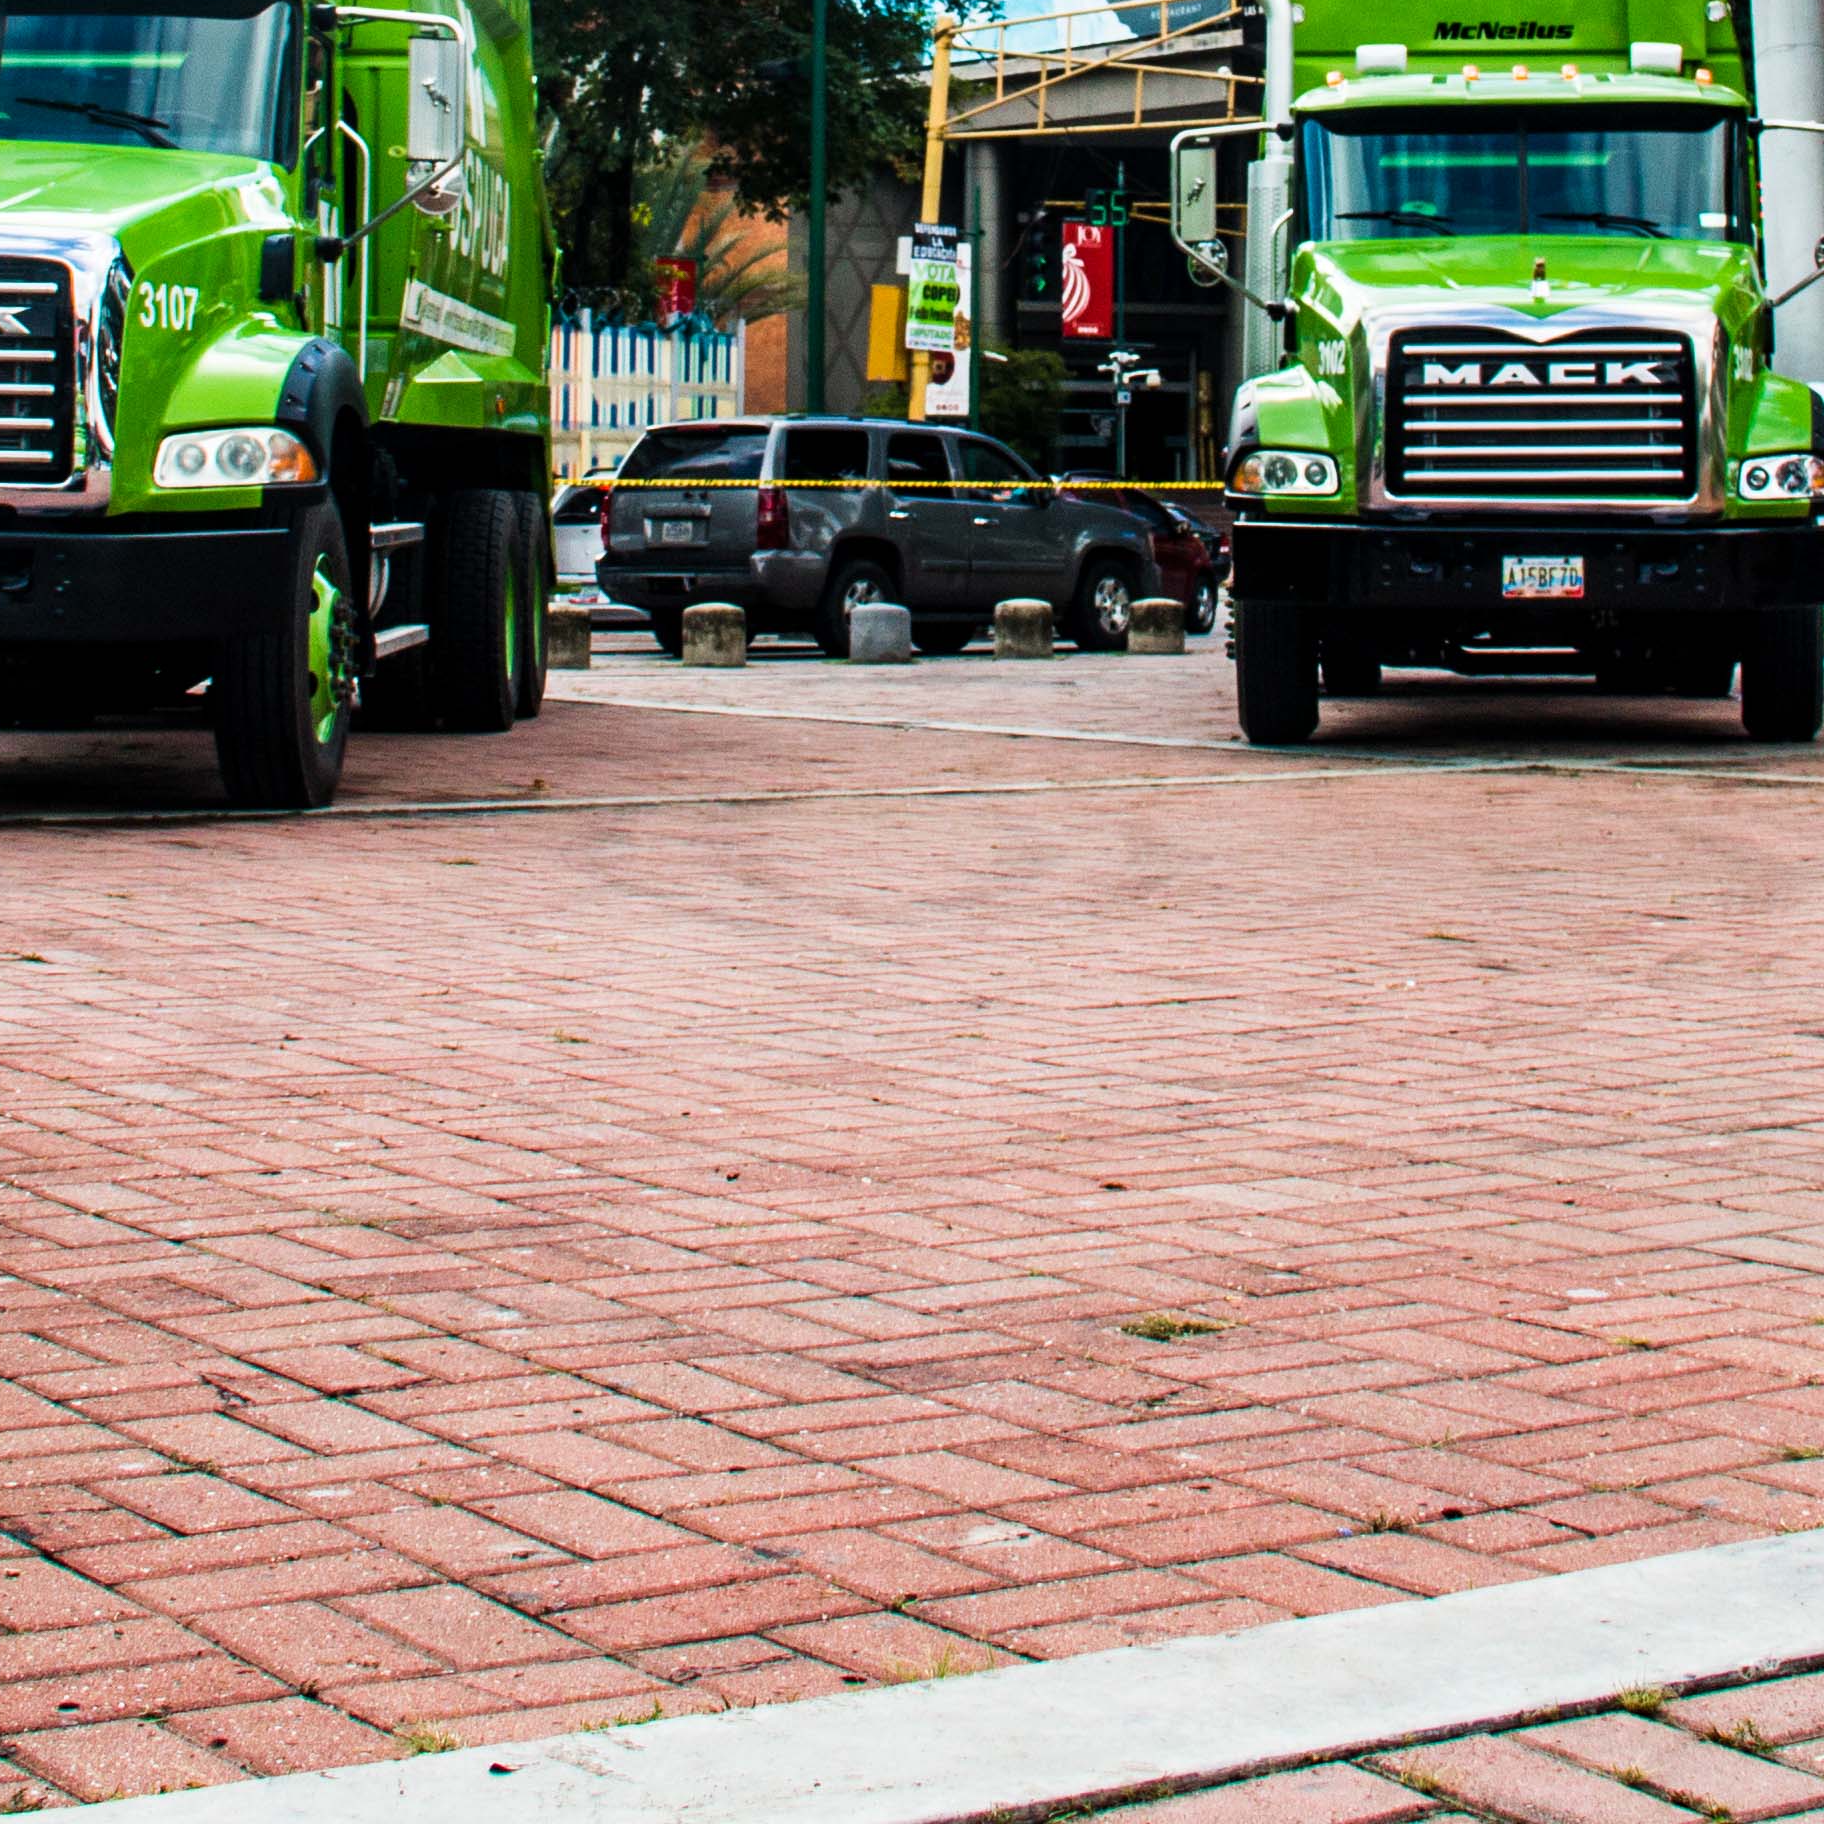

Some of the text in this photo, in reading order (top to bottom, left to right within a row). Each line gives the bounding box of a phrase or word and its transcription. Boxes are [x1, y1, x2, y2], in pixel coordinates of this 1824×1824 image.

[1434, 21, 1575, 40] McNeilus
[914, 261, 957, 281] VOTA
[138, 282, 199, 331] 3107
[1422, 362, 1664, 385] MACK
